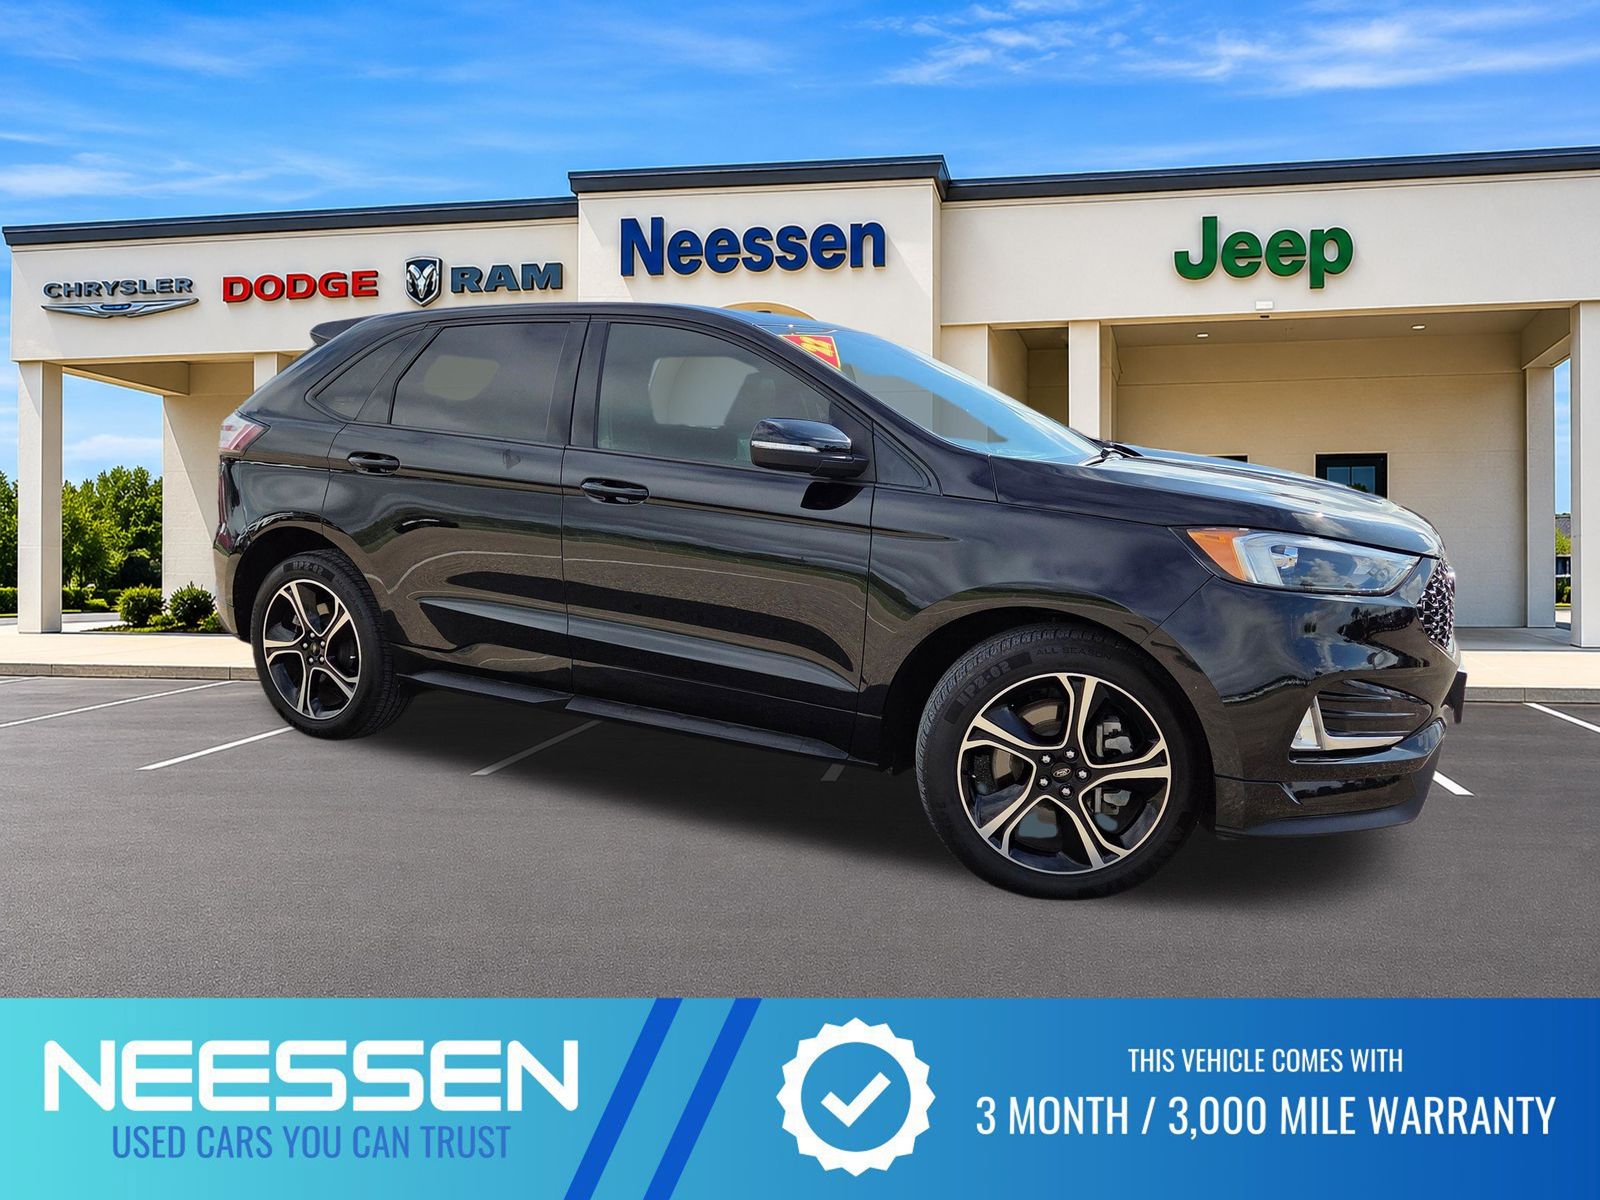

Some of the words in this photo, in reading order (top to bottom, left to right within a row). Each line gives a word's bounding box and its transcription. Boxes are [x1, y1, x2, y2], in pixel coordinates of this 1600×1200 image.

[620, 216, 887, 277] Neessen
[1174, 215, 1354, 289] Jeep
[43, 277, 194, 299] CHRYSLER
[222, 270, 379, 303] DODGE
[450, 262, 563, 293] RAM
